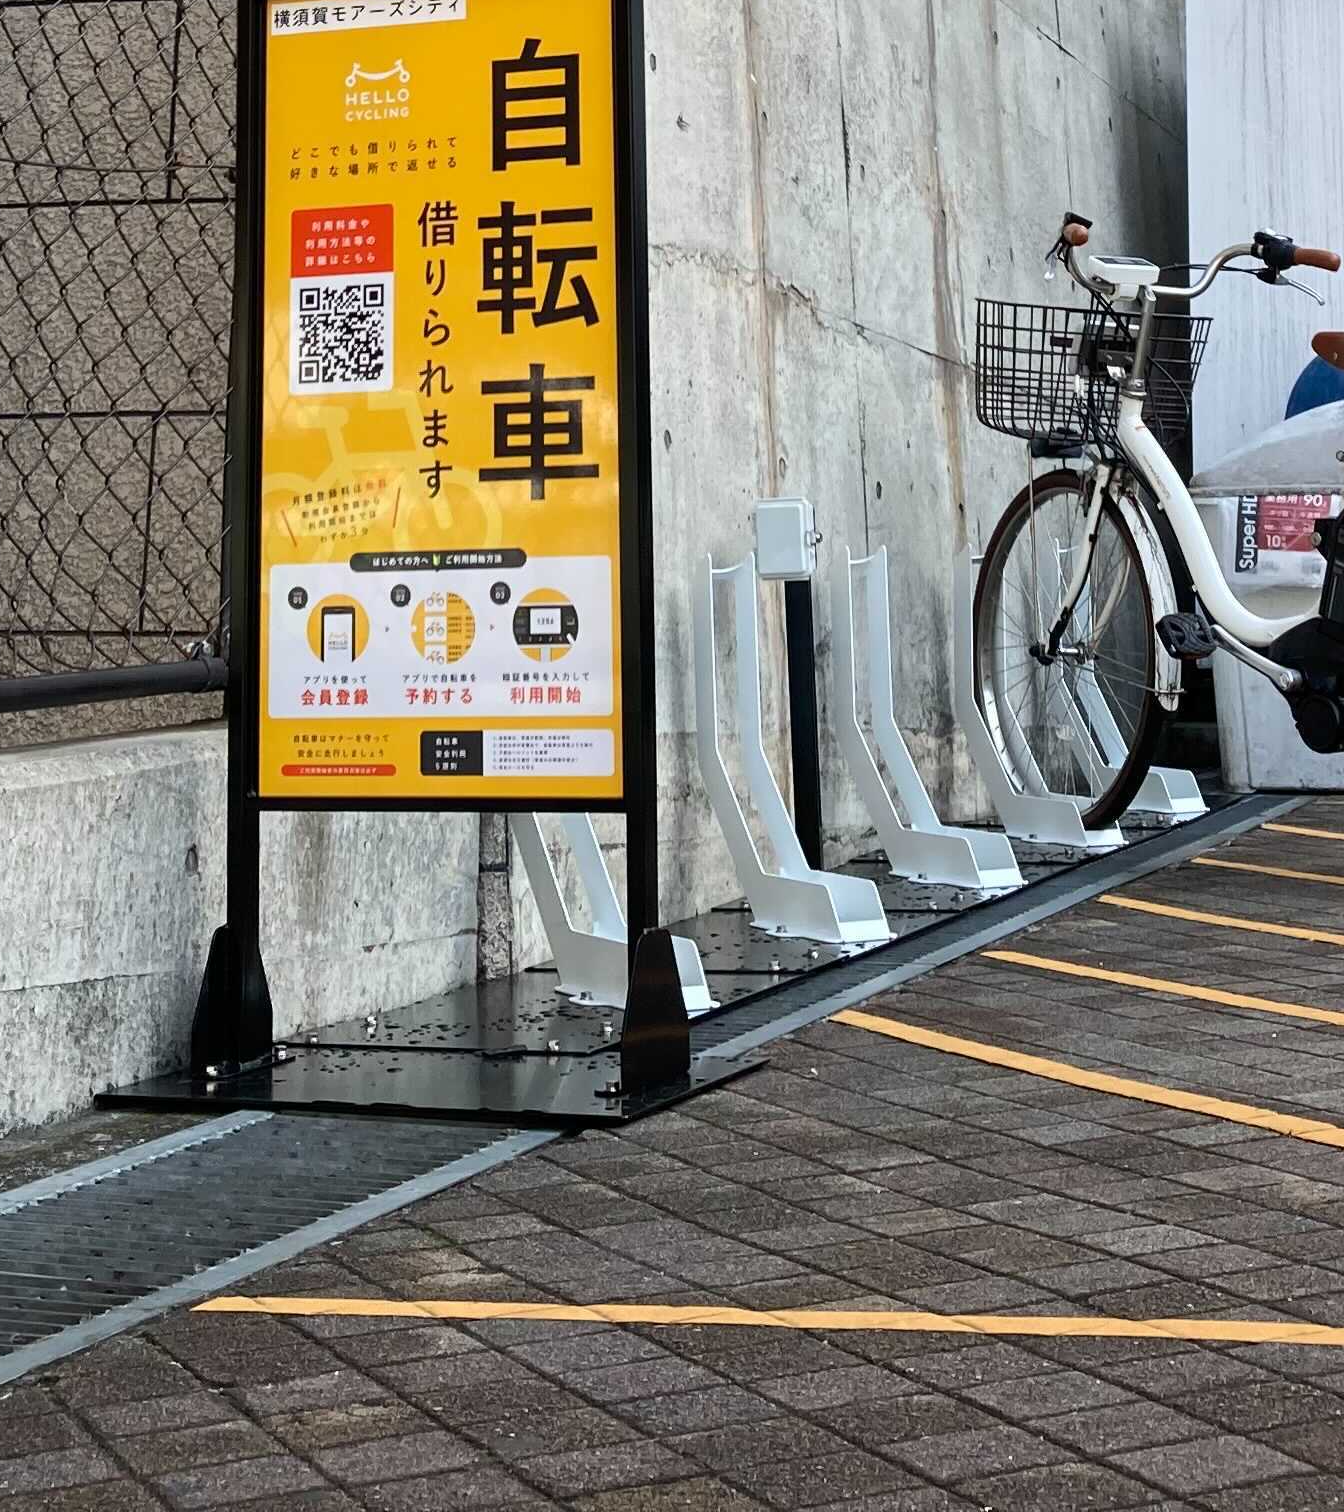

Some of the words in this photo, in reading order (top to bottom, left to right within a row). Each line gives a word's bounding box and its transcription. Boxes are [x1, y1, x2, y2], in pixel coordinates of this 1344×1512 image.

[344, 88, 411, 106] HELLO
[344, 106, 411, 123] CYCLING
[291, 136, 457, 160] どこでも借りられて
[290, 156, 457, 181] 好きな場所で返せる
[476, 38, 601, 501] 自転車
[418, 200, 459, 499] 借りられます
[1239, 517, 1258, 569] Super
[303, 675, 368, 685] アプリを使って
[402, 673, 477, 684] アプリで自転車を
[301, 688, 369, 706] 会員登録
[405, 687, 473, 705] 予約する
[510, 686, 582, 705] 利用開始
